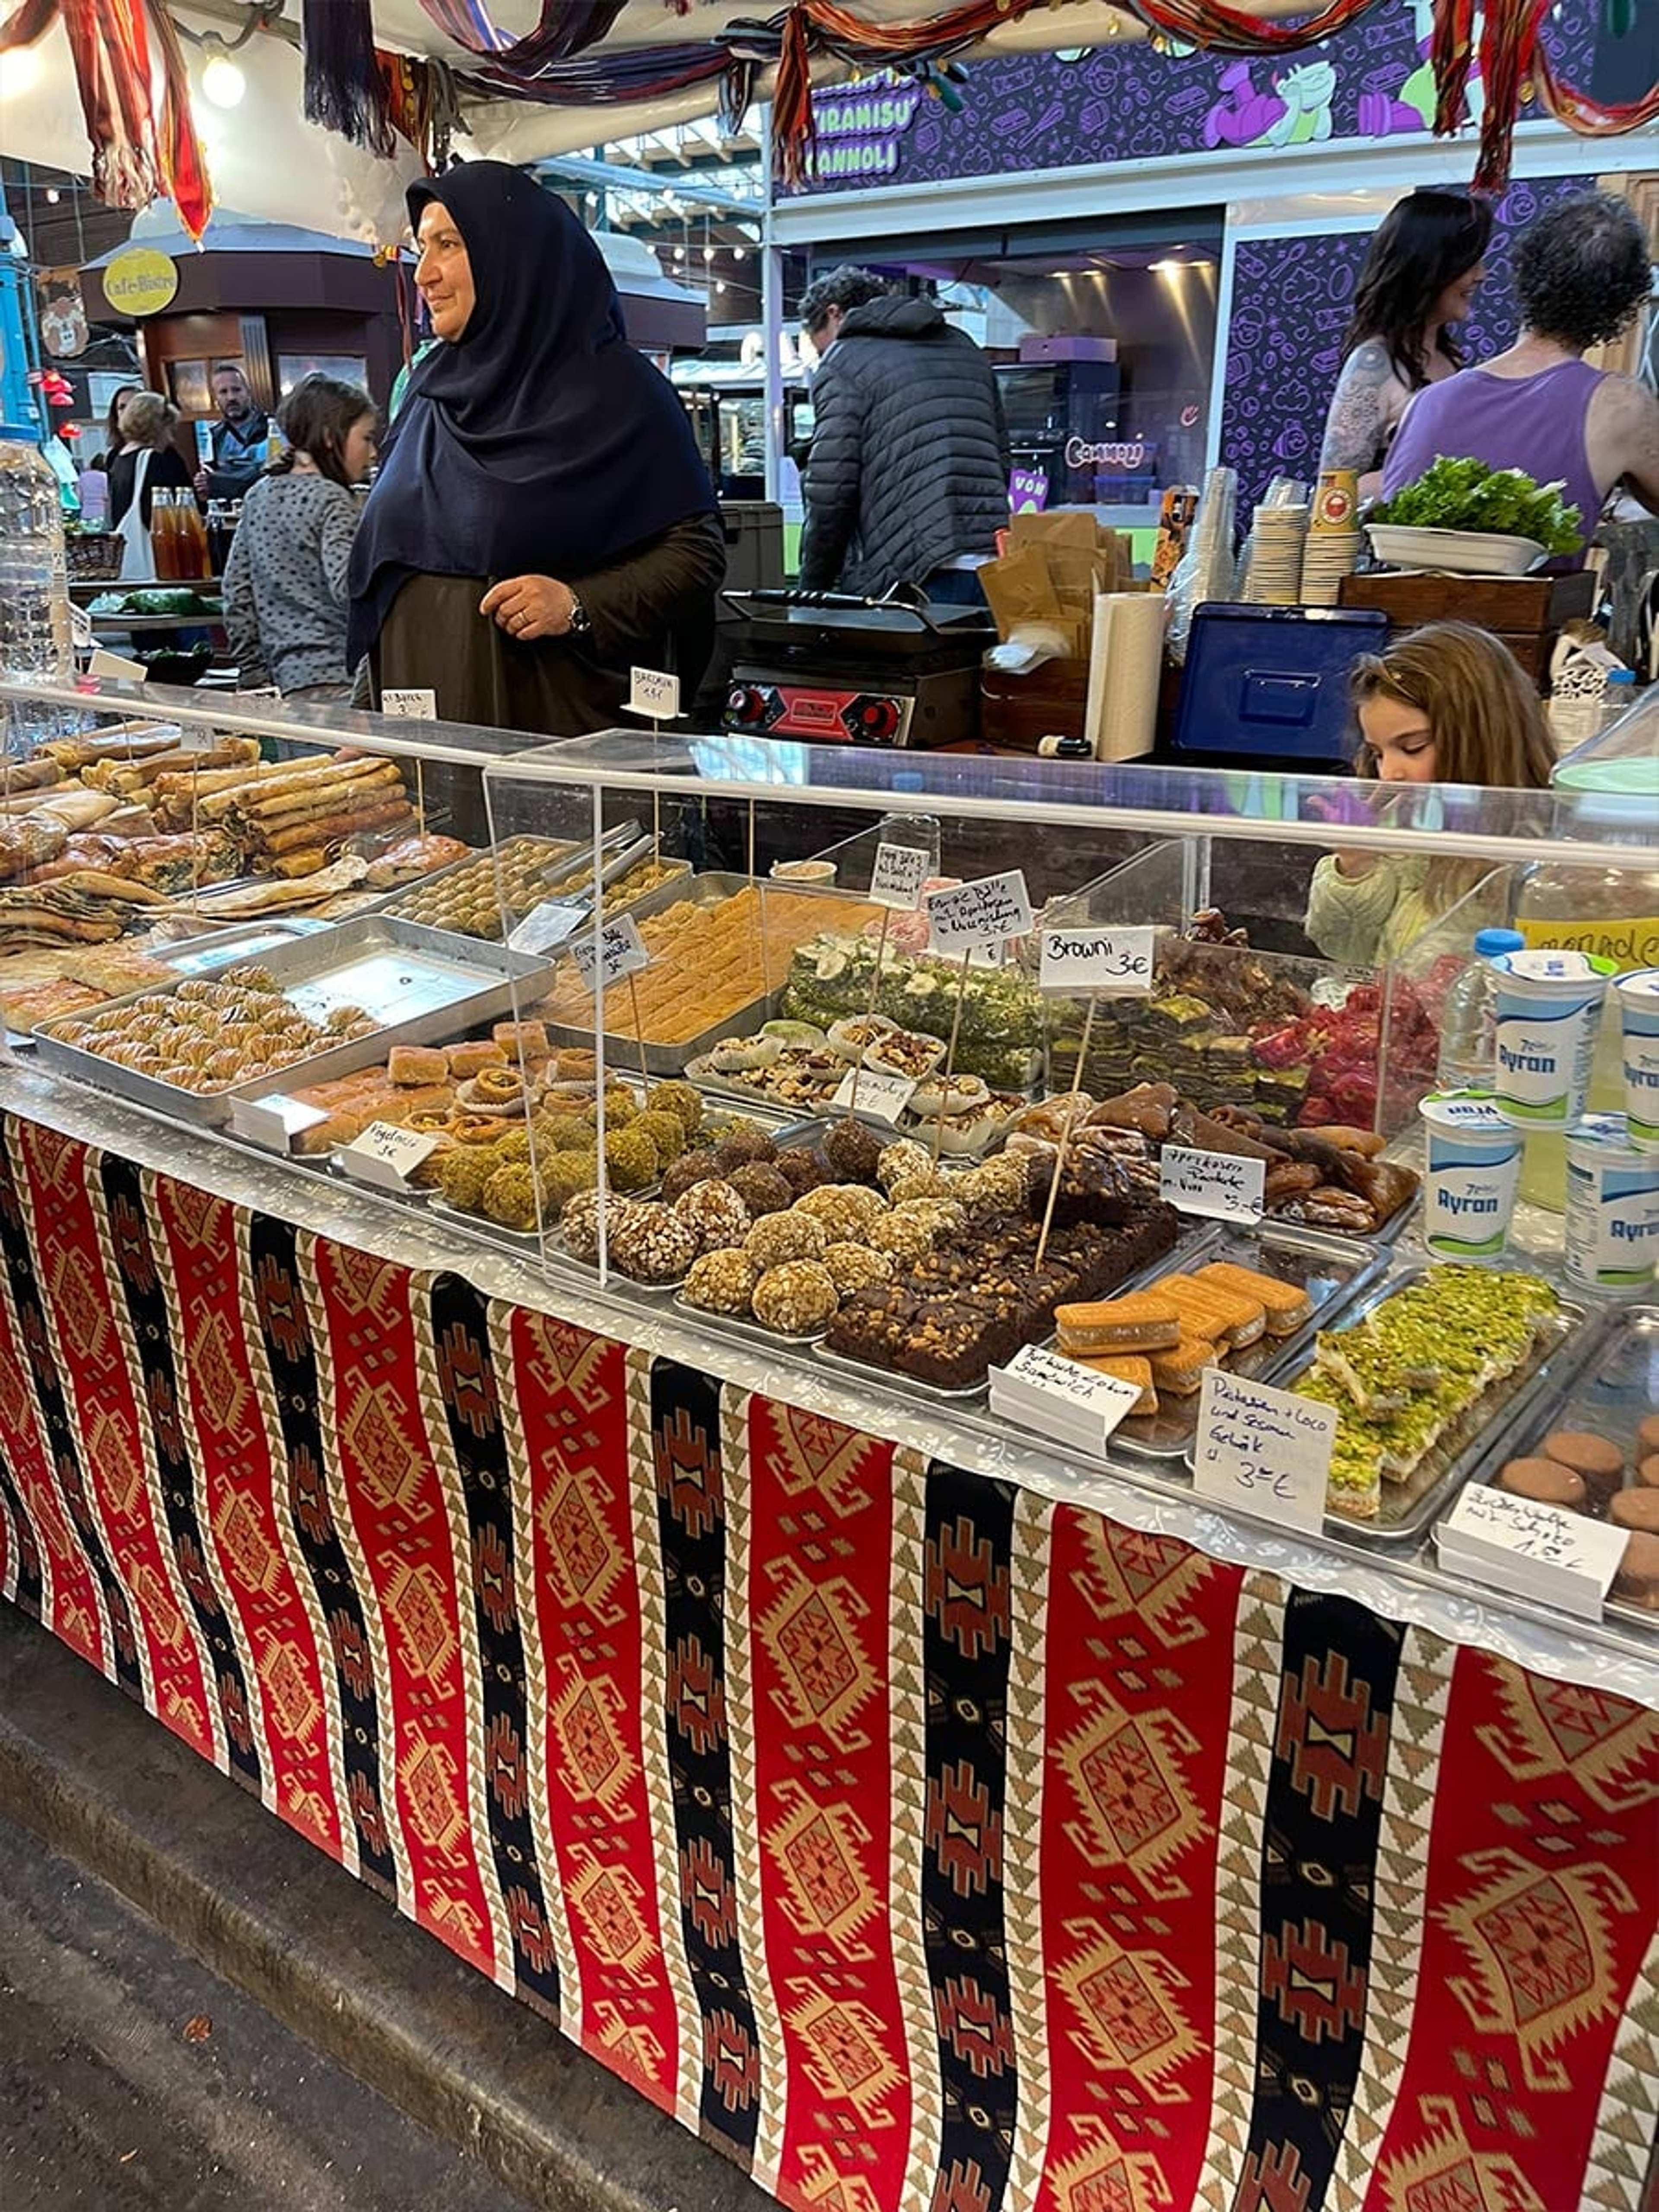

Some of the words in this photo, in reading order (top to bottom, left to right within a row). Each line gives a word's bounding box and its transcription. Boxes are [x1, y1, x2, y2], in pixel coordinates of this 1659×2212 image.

[1047, 934, 1113, 960] Browni
[1500, 1043, 1555, 1073] Ayran
[1438, 1187, 1498, 1215] Ayran
